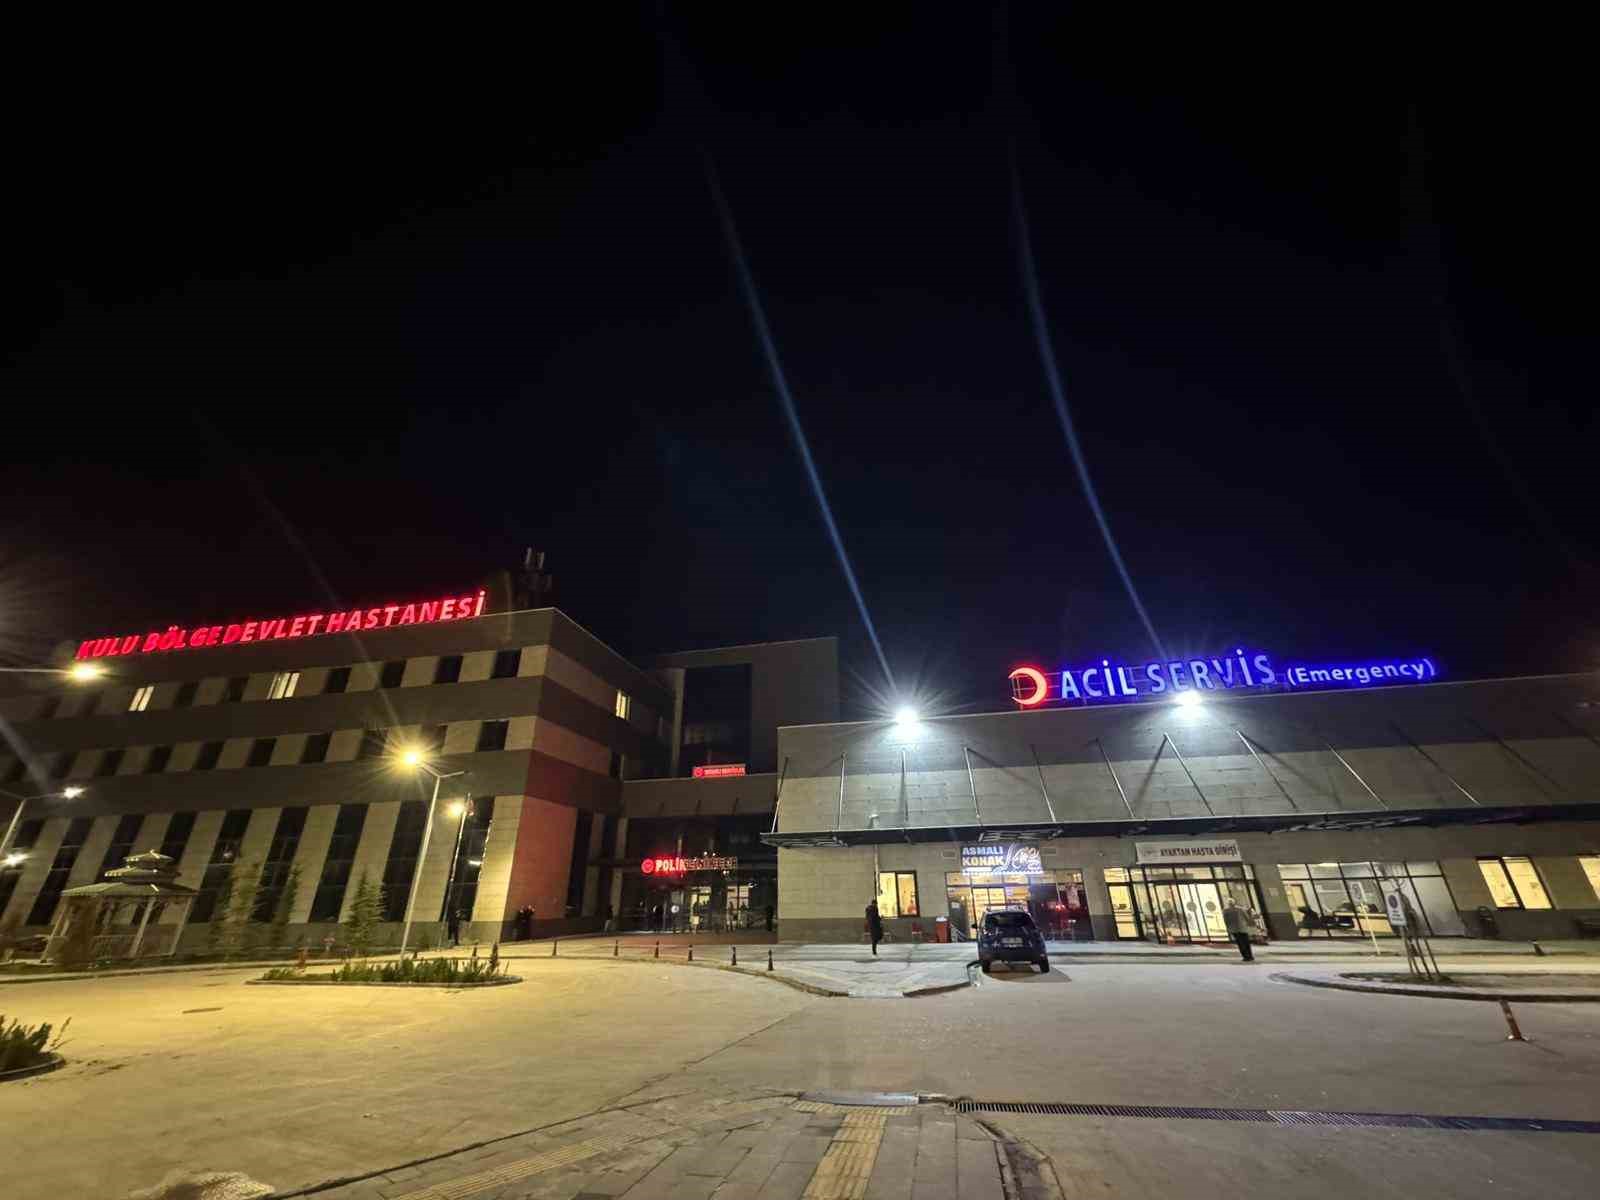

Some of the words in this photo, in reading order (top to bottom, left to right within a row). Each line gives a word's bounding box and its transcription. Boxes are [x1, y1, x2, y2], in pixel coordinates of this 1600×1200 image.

[76, 636, 140, 659] KULU
[142, 625, 223, 652] BÖLGE
[223, 614, 323, 644] DEVLET
[326, 590, 486, 633] HASTANESİ
[1061, 660, 1137, 698] ACİL
[1147, 649, 1275, 692] SERVİS
[1287, 658, 1435, 686] (Emergency)
